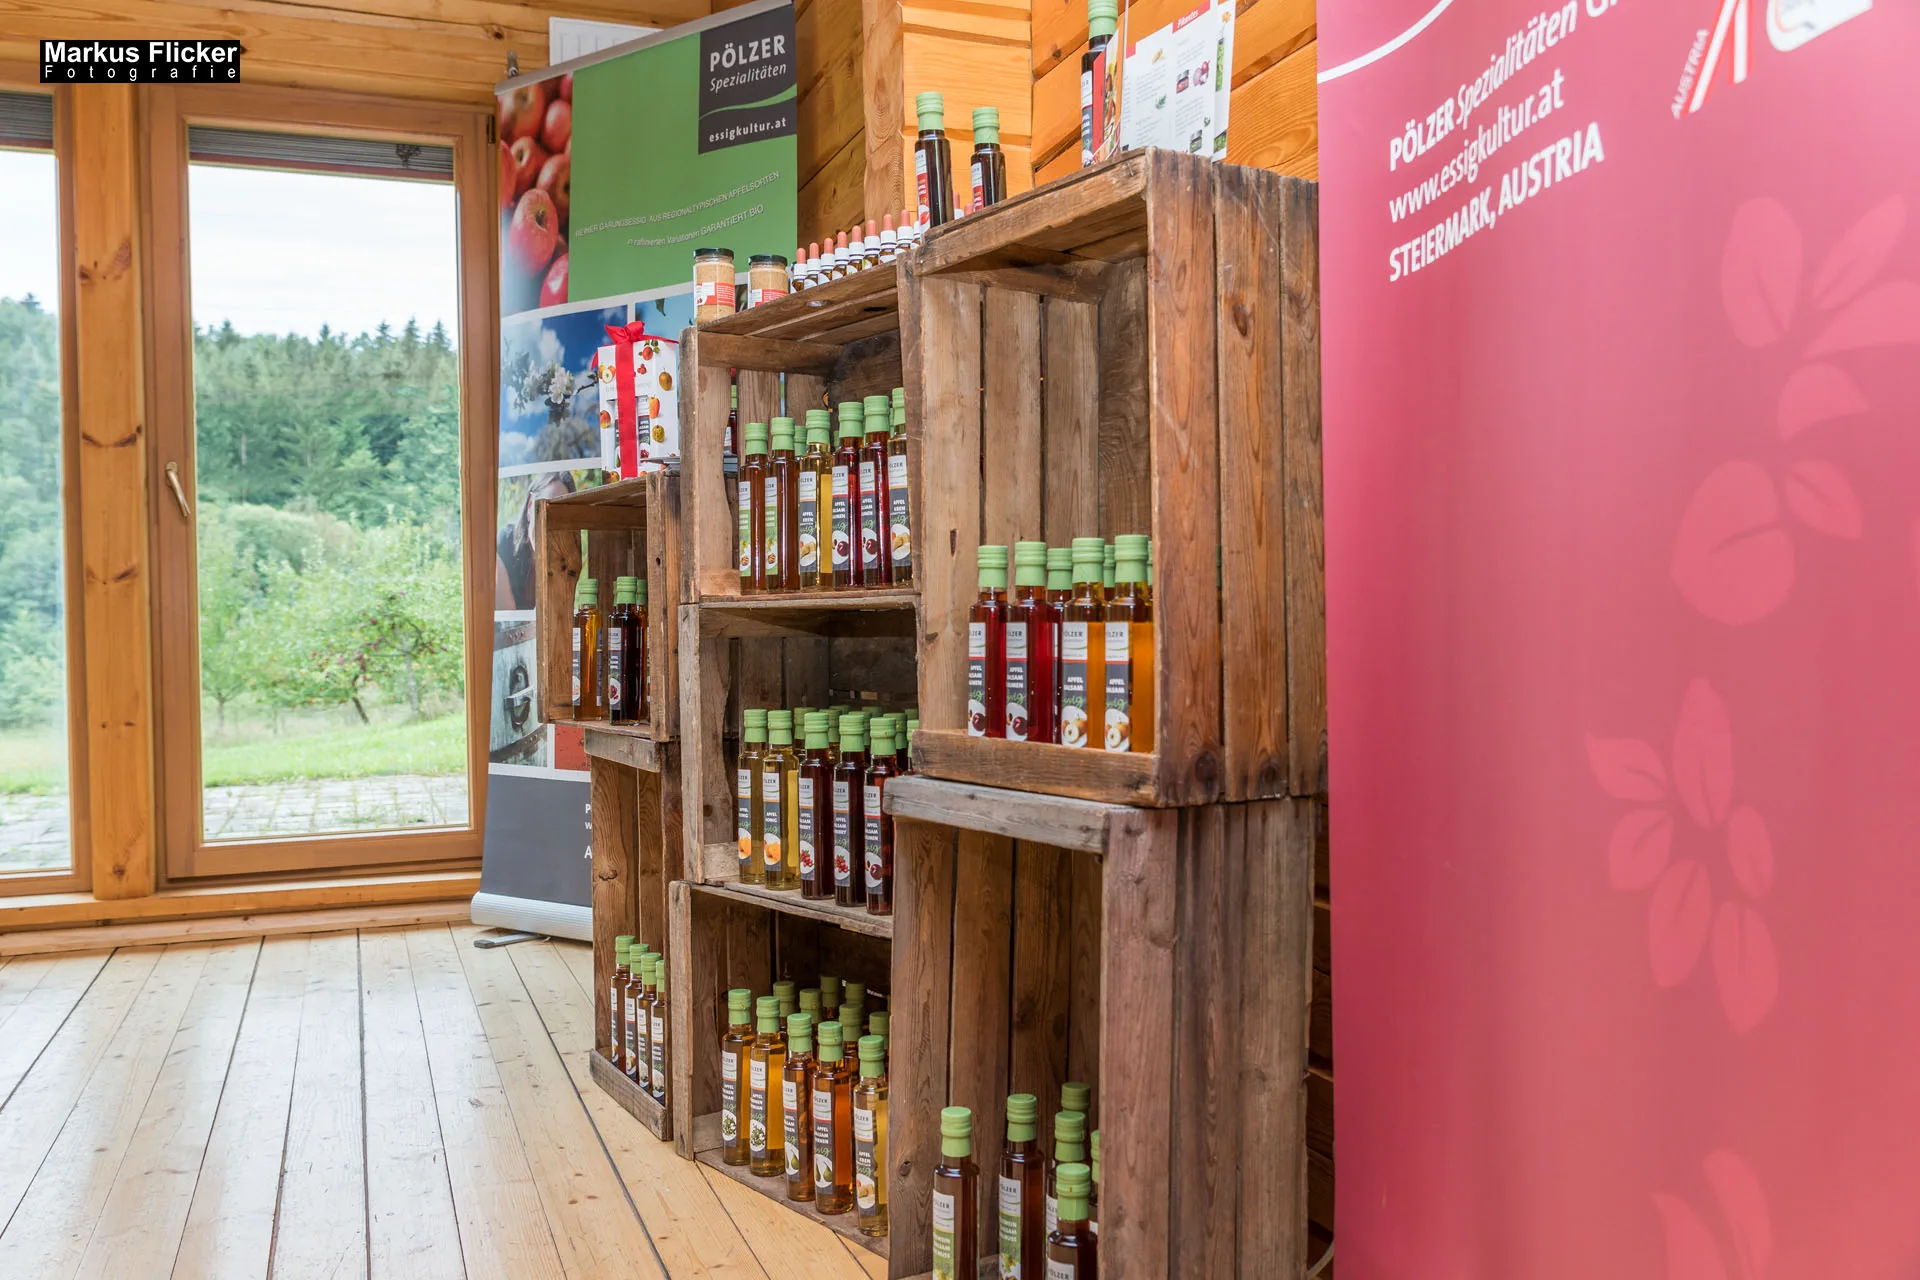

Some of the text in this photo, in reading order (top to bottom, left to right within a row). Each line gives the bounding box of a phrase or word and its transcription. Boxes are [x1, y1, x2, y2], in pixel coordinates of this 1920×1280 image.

[710, 34, 786, 72] PÖLZER
[709, 63, 787, 94] Spezialitäten
[1390, 0, 1578, 172] PÖLZER Spezialitäten
[709, 117, 787, 142] essigkultur.at
[1389, 68, 1565, 223] www.essigkultur.at
[728, 171, 780, 199] APFELSORTEN
[1389, 121, 1605, 282] STEIERMARK, AUSTRIA
[700, 210, 748, 236] GARANTIERT
[748, 203, 764, 217] BIO
